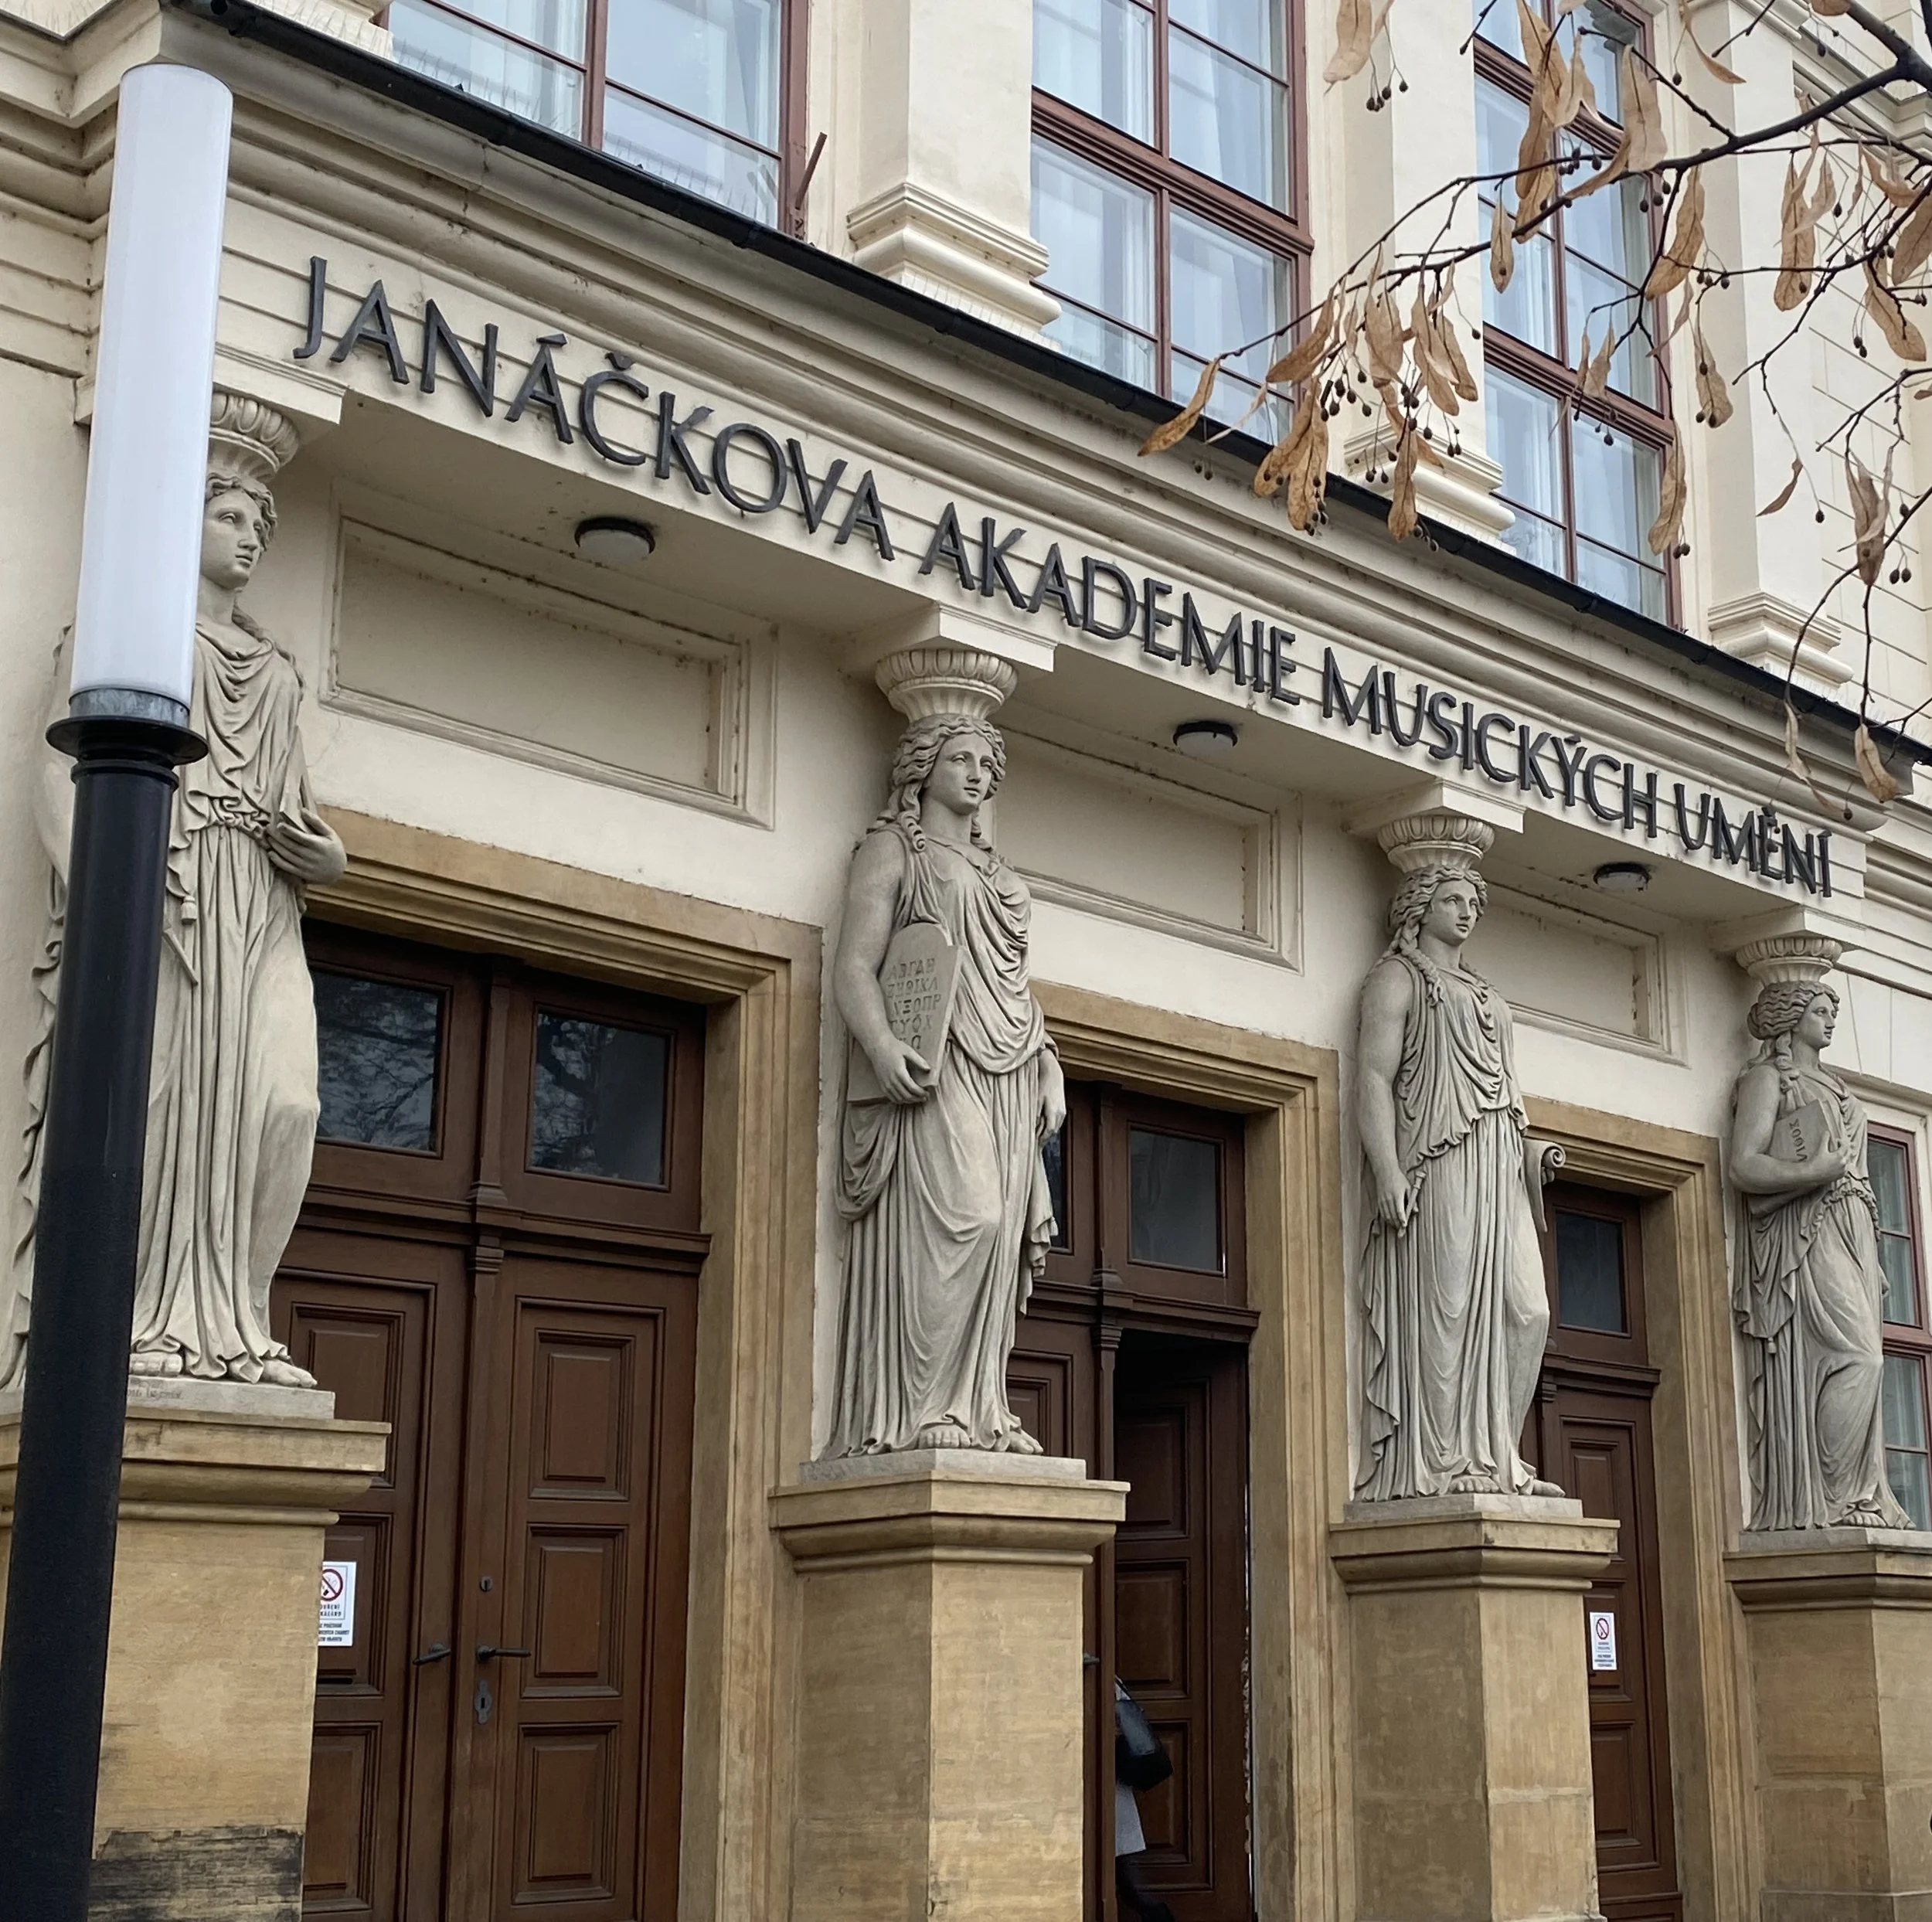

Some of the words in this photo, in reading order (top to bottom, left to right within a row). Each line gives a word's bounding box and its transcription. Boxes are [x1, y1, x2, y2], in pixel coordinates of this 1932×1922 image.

[293, 255, 895, 562] JANÁČKOVA
[918, 502, 1300, 706] AKADEMIE
[1322, 647, 1658, 839] MUSICKÝCH
[1673, 782, 1832, 898] UMĚNÍ
